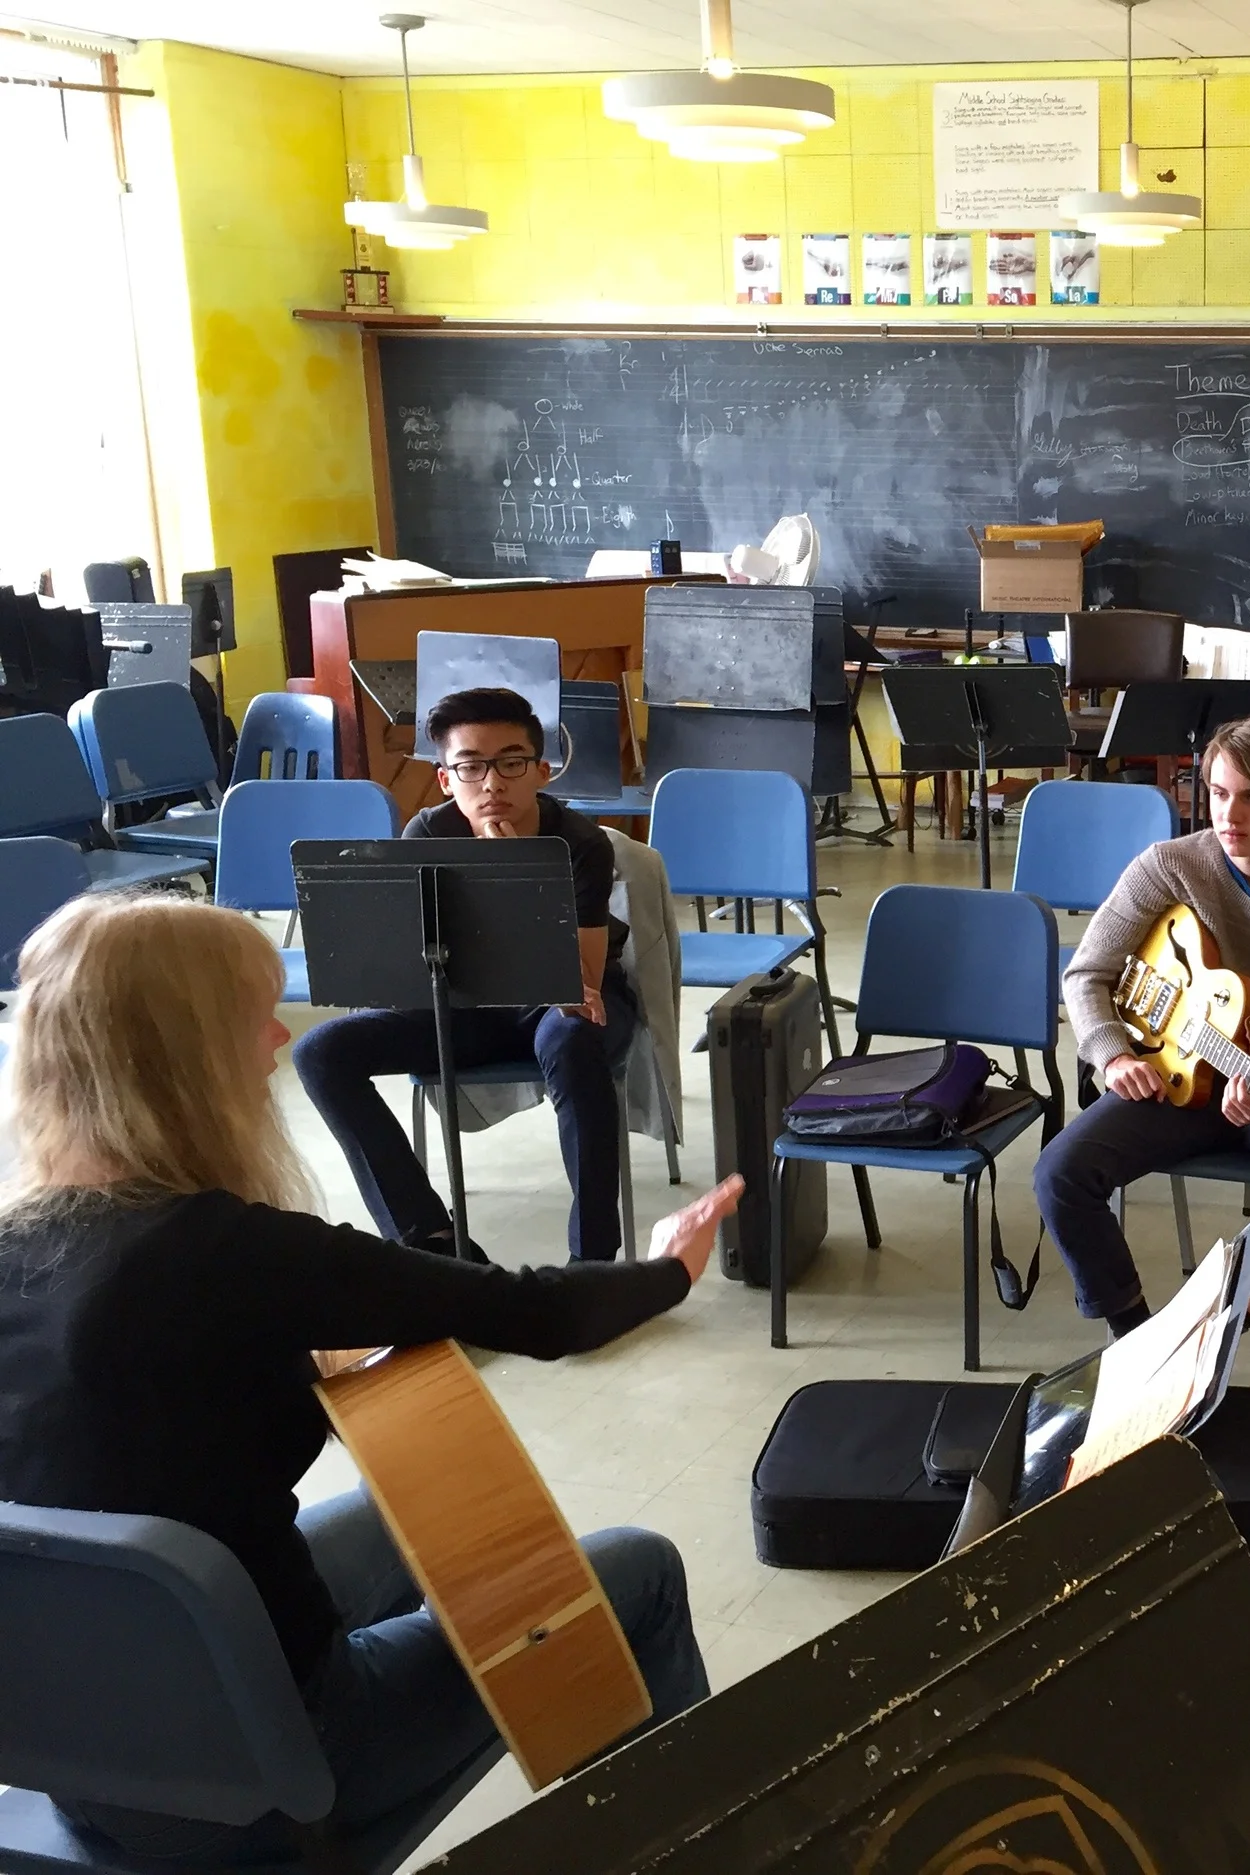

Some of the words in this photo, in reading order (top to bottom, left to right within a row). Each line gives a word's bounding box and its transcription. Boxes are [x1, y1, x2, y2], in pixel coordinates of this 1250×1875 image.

[958, 91, 984, 105] Middle
[985, 90, 1006, 105] School
[820, 289, 834, 304] Re
[942, 289, 954, 304] Fa
[1004, 289, 1018, 304] So
[1068, 289, 1081, 303] La
[1164, 364, 1249, 393] Theme
[1176, 411, 1222, 433] Death
[579, 427, 605, 446] Half
[591, 472, 633, 488] Quarter
[1185, 509, 1221, 527] Minor
